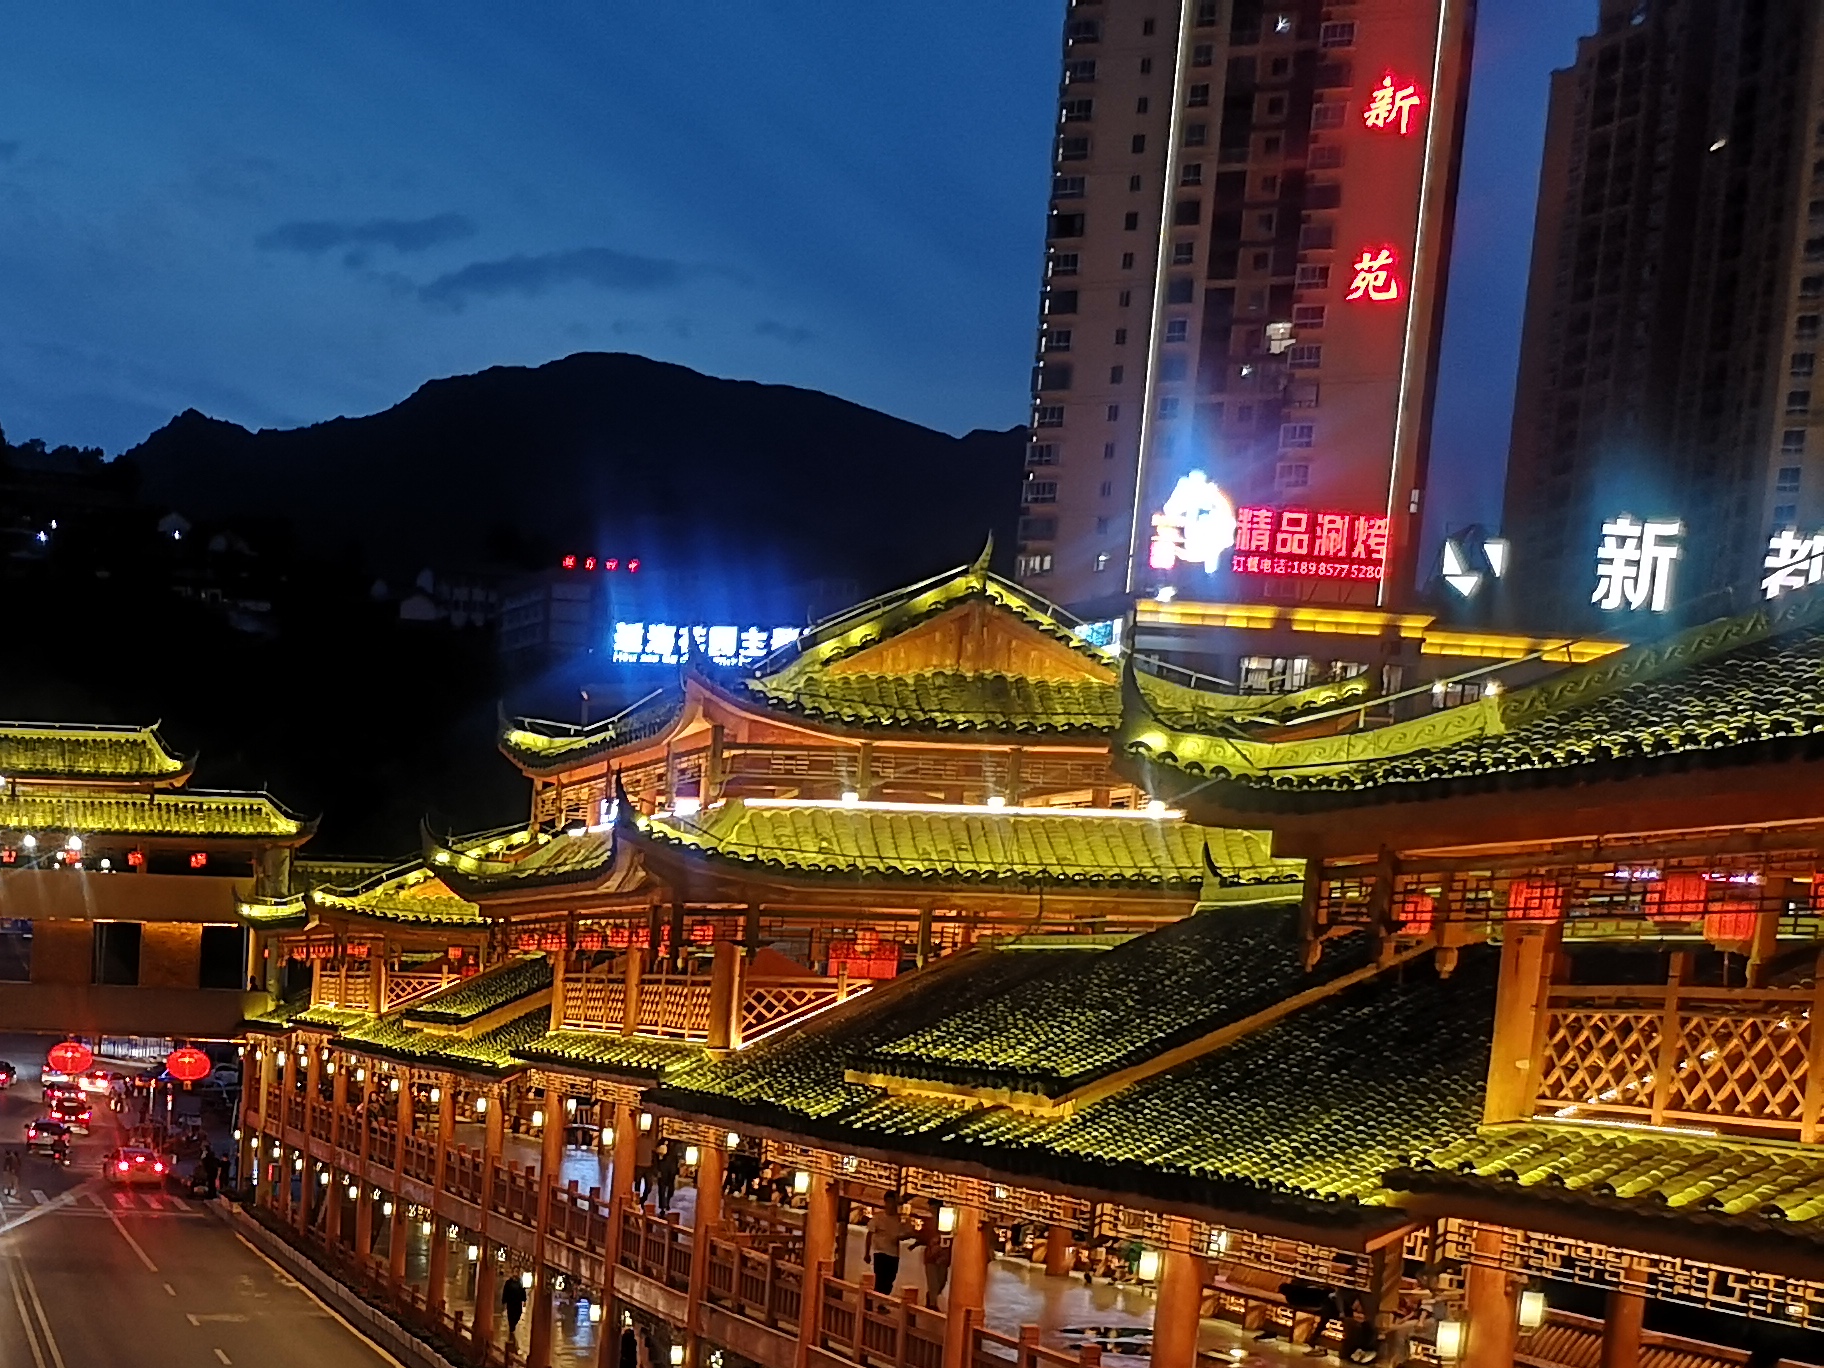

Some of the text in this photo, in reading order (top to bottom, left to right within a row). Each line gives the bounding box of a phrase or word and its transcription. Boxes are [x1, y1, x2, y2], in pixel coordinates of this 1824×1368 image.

[1346, 76, 1420, 301] 新苑
[1236, 508, 1389, 560] 精品涮烤
